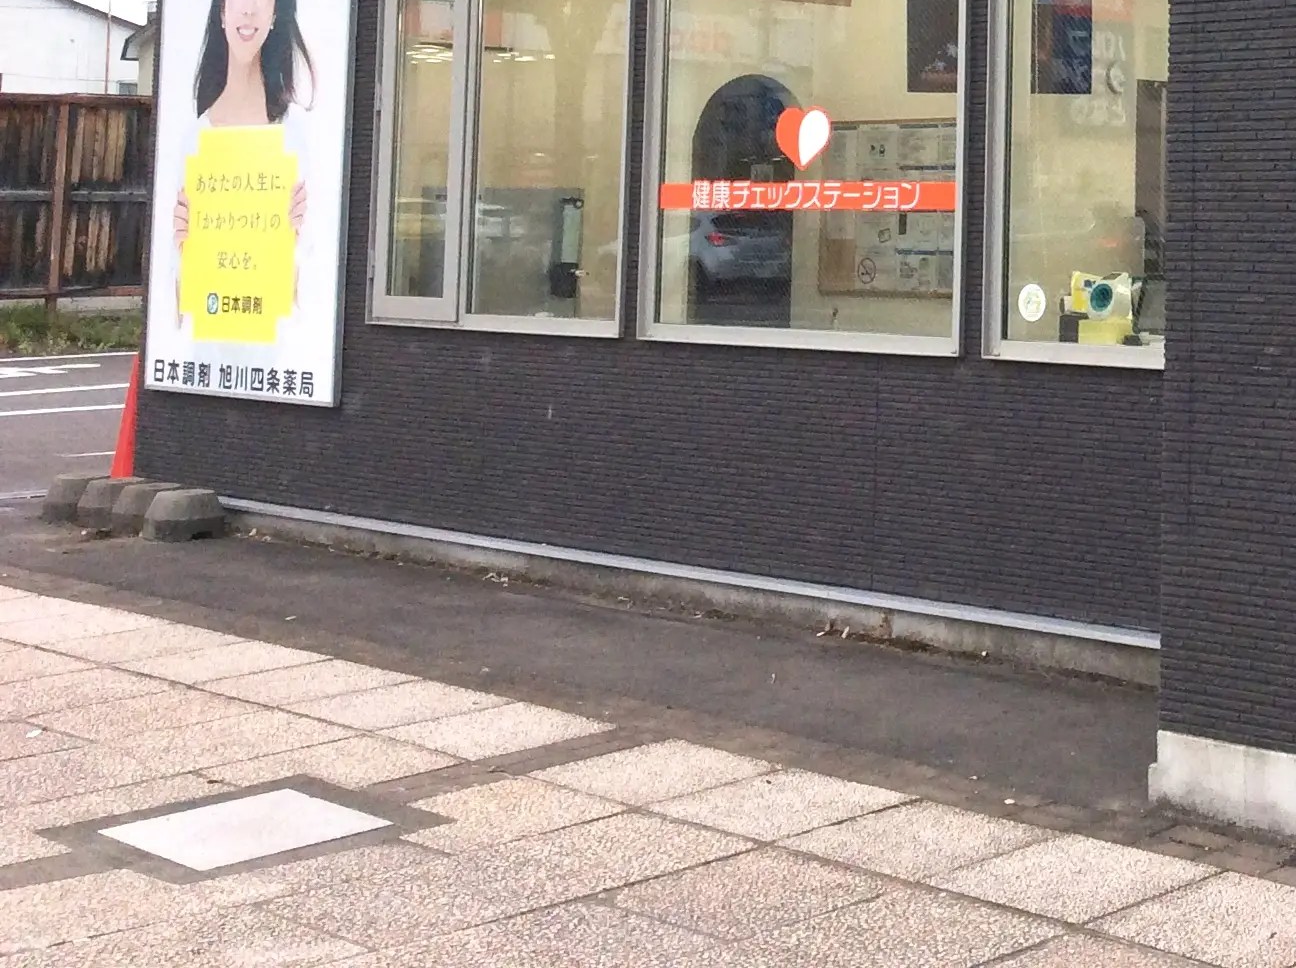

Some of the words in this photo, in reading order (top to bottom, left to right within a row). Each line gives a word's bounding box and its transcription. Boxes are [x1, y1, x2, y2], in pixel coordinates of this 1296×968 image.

[692, 180, 921, 210] 健康チェックステーション
[221, 296, 263, 315] 日本調剤
[154, 359, 211, 388] 日本調剤
[218, 364, 314, 397] 旭川四条薬局
